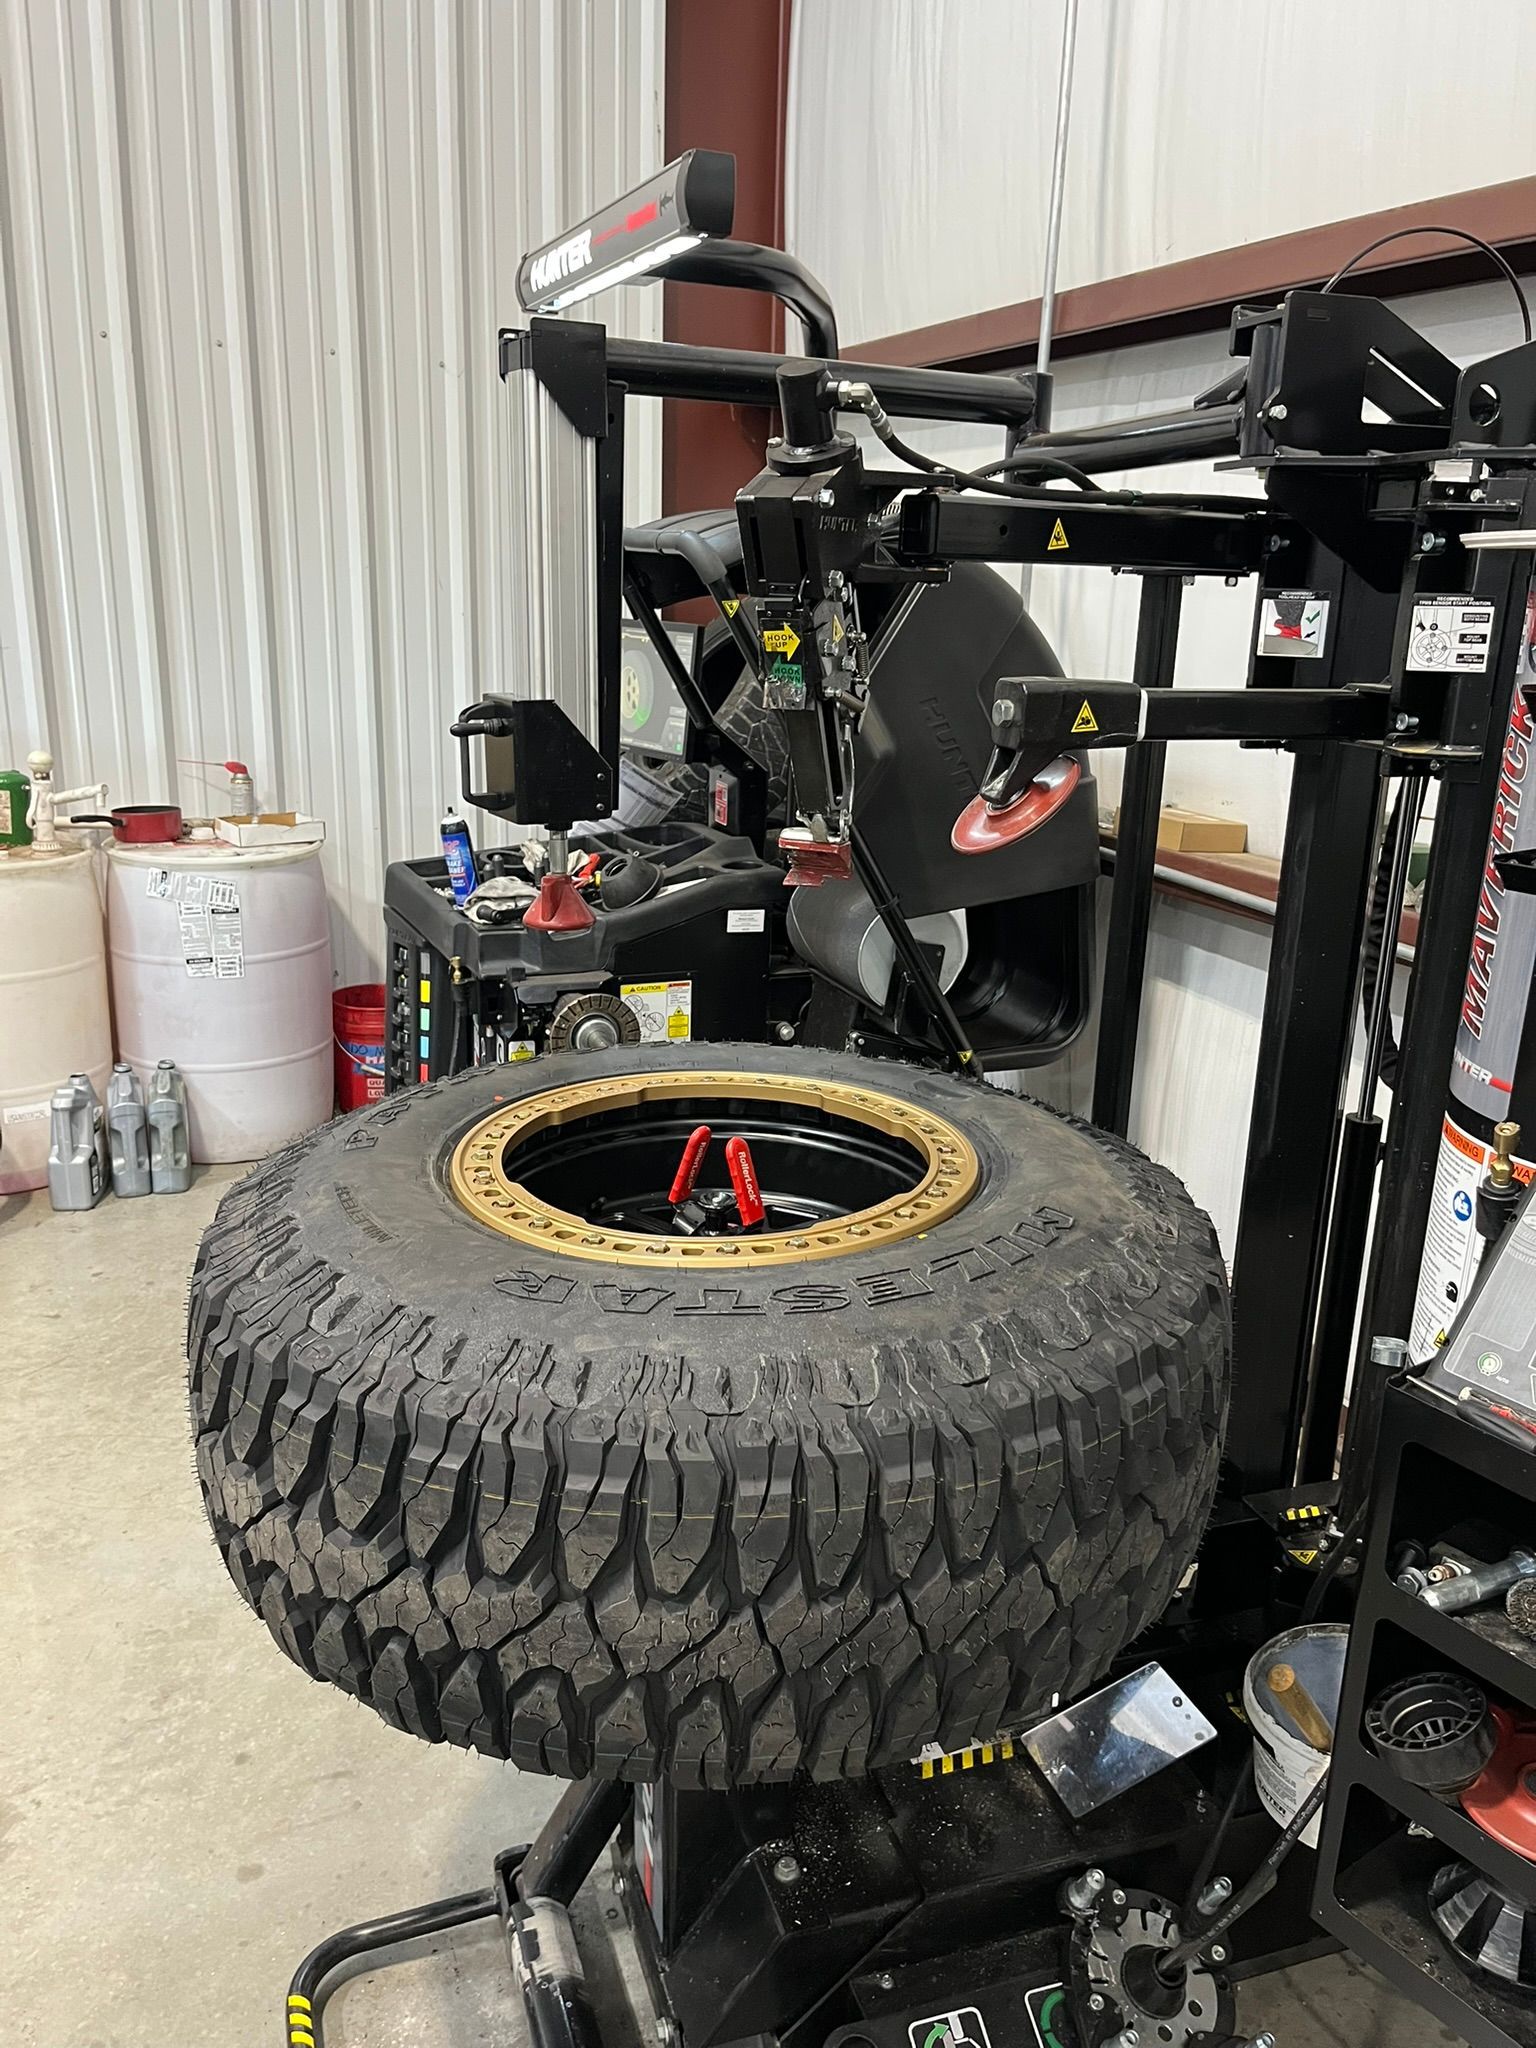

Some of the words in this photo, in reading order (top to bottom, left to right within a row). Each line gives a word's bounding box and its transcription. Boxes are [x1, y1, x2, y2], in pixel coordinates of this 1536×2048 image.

[530, 229, 593, 293] HUNTER
[767, 634, 794, 642] HOOK
[774, 667, 801, 675] HOOK
[1460, 682, 1535, 1041] MAVERICK
[1449, 1127, 1480, 1158] WARNING
[738, 1151, 757, 1203] RollerLock
[493, 1205, 1076, 1316] MILESTAR
